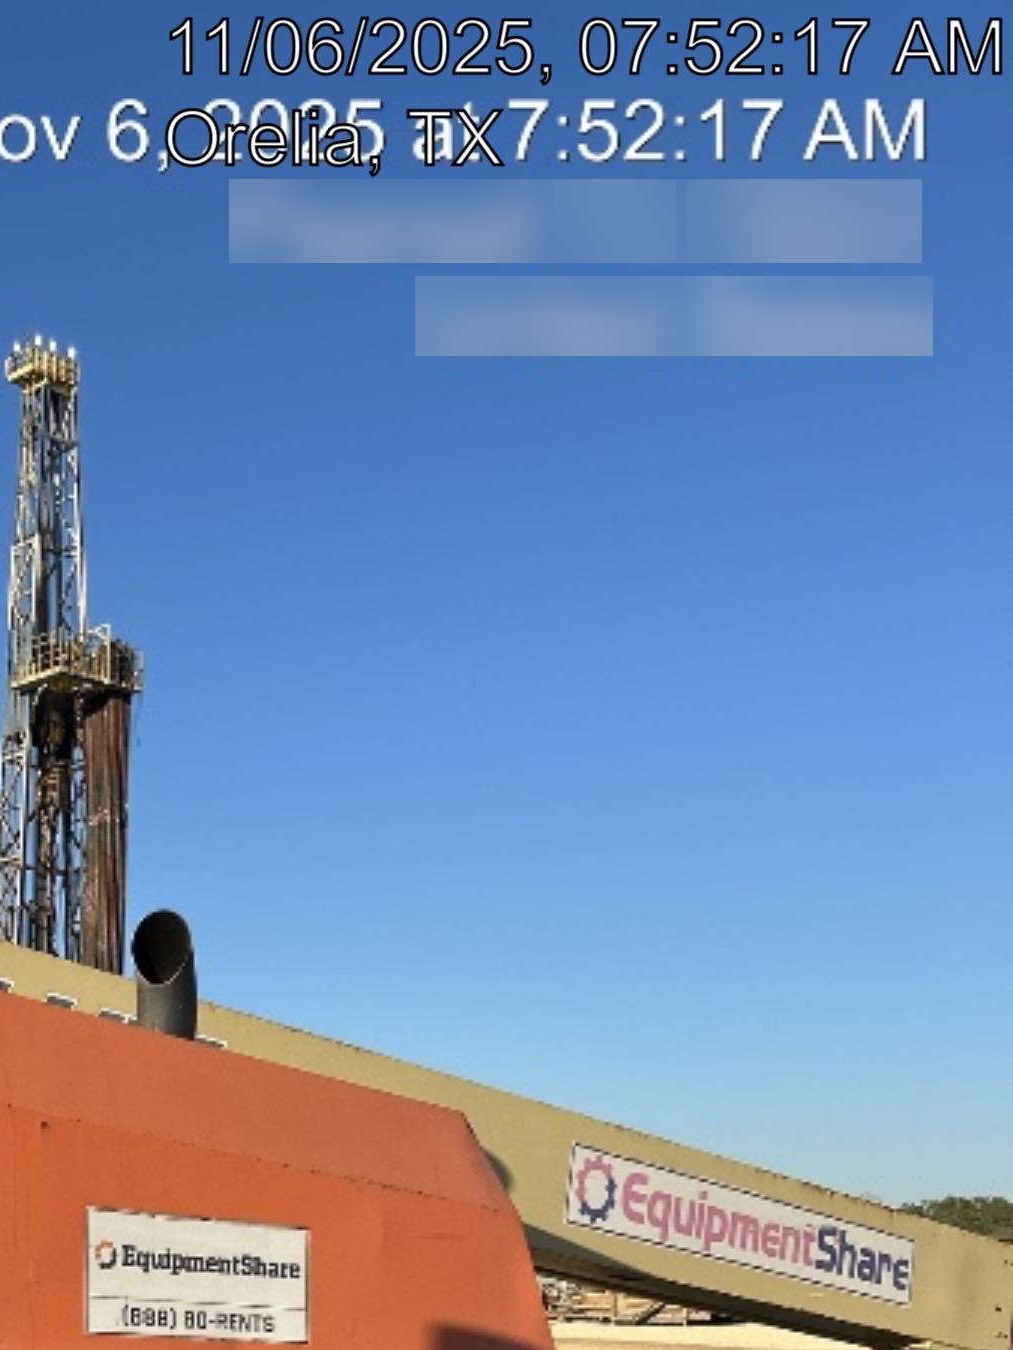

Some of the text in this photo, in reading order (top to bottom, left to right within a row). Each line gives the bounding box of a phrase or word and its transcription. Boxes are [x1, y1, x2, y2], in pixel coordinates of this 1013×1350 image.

[621, 1171, 910, 1291] EquipmentShare
[120, 1243, 301, 1279] EquipmentShare
[121, 1303, 177, 1330] (888)
